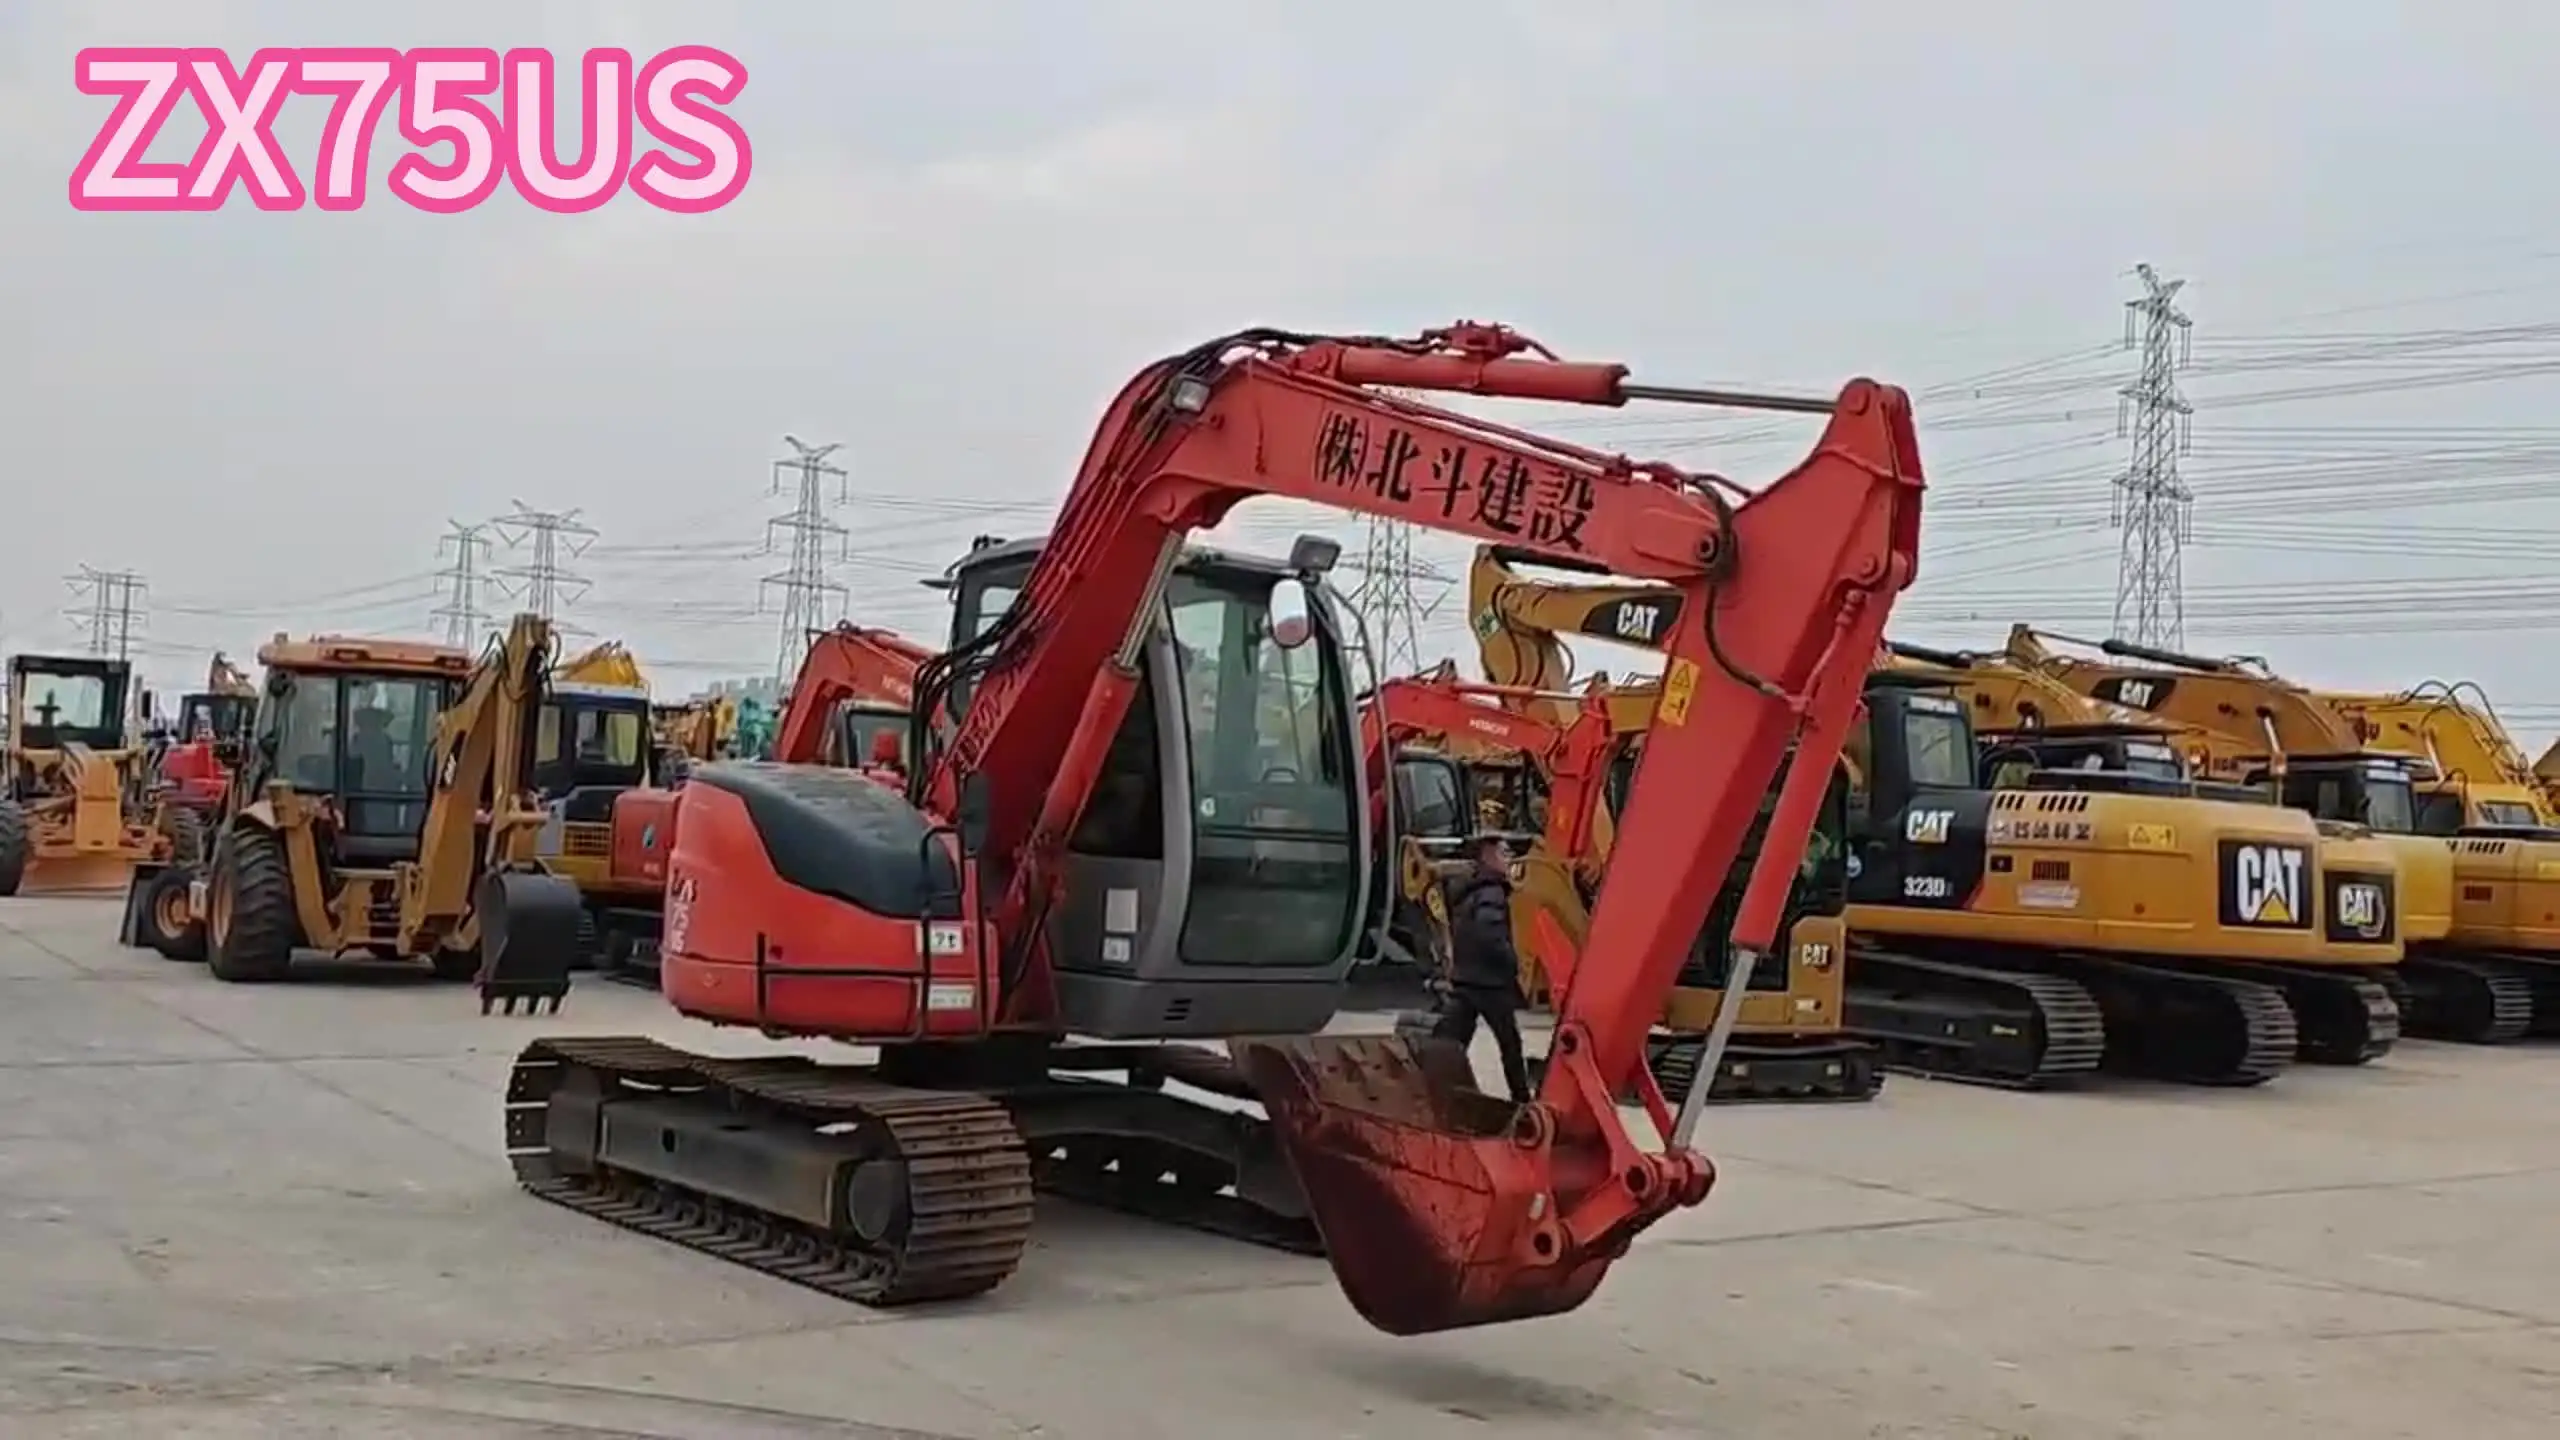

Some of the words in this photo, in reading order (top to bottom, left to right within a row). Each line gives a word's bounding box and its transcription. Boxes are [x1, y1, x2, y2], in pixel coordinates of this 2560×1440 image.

[1615, 601, 1660, 641] CAT
[2118, 679, 2154, 709] CAT
[1906, 809, 1956, 844] CAT
[2236, 845, 2303, 924] CAT
[2338, 886, 2375, 927] CAT
[1802, 943, 1831, 967] CAT
